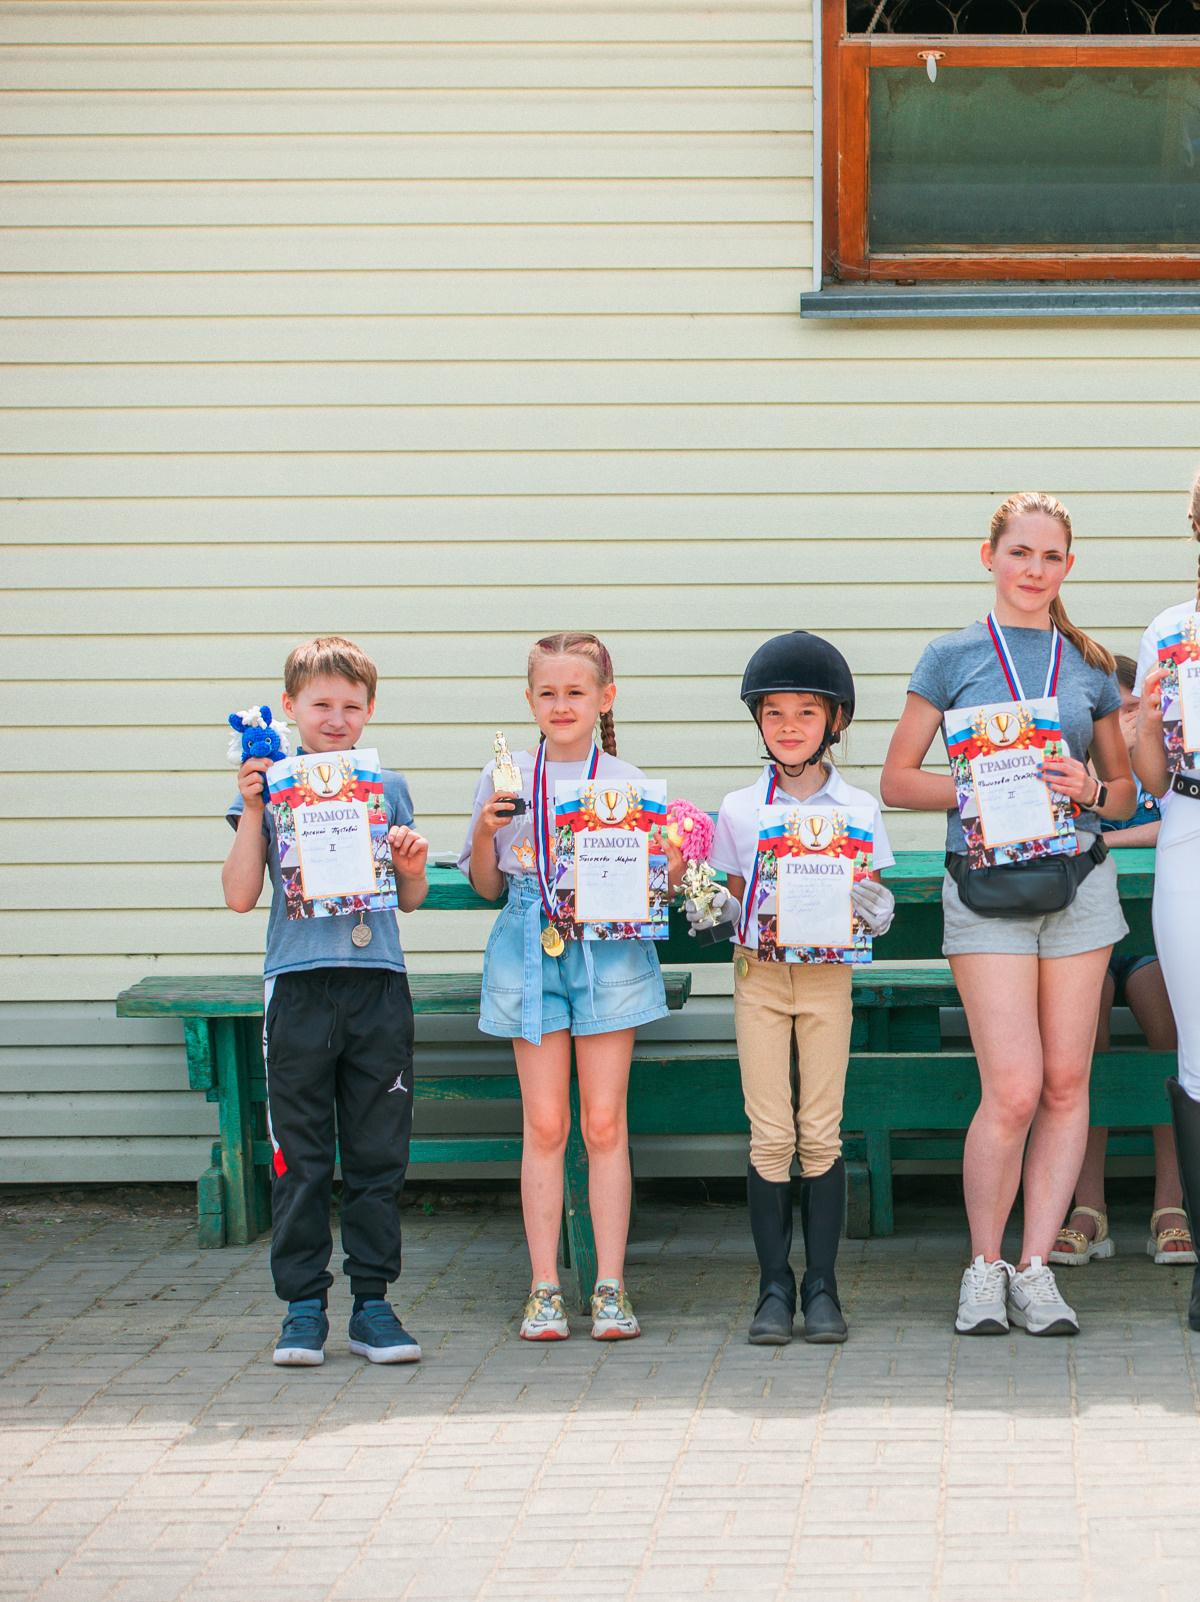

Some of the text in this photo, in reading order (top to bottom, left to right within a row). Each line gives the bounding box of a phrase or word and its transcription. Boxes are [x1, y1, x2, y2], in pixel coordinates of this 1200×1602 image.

[979, 755, 1036, 774] ГРАМОТА
[302, 808, 360, 824] ГРАМОТА
[583, 837, 640, 849] ГРАМОТА
[785, 863, 845, 875] ГРАМОТА
